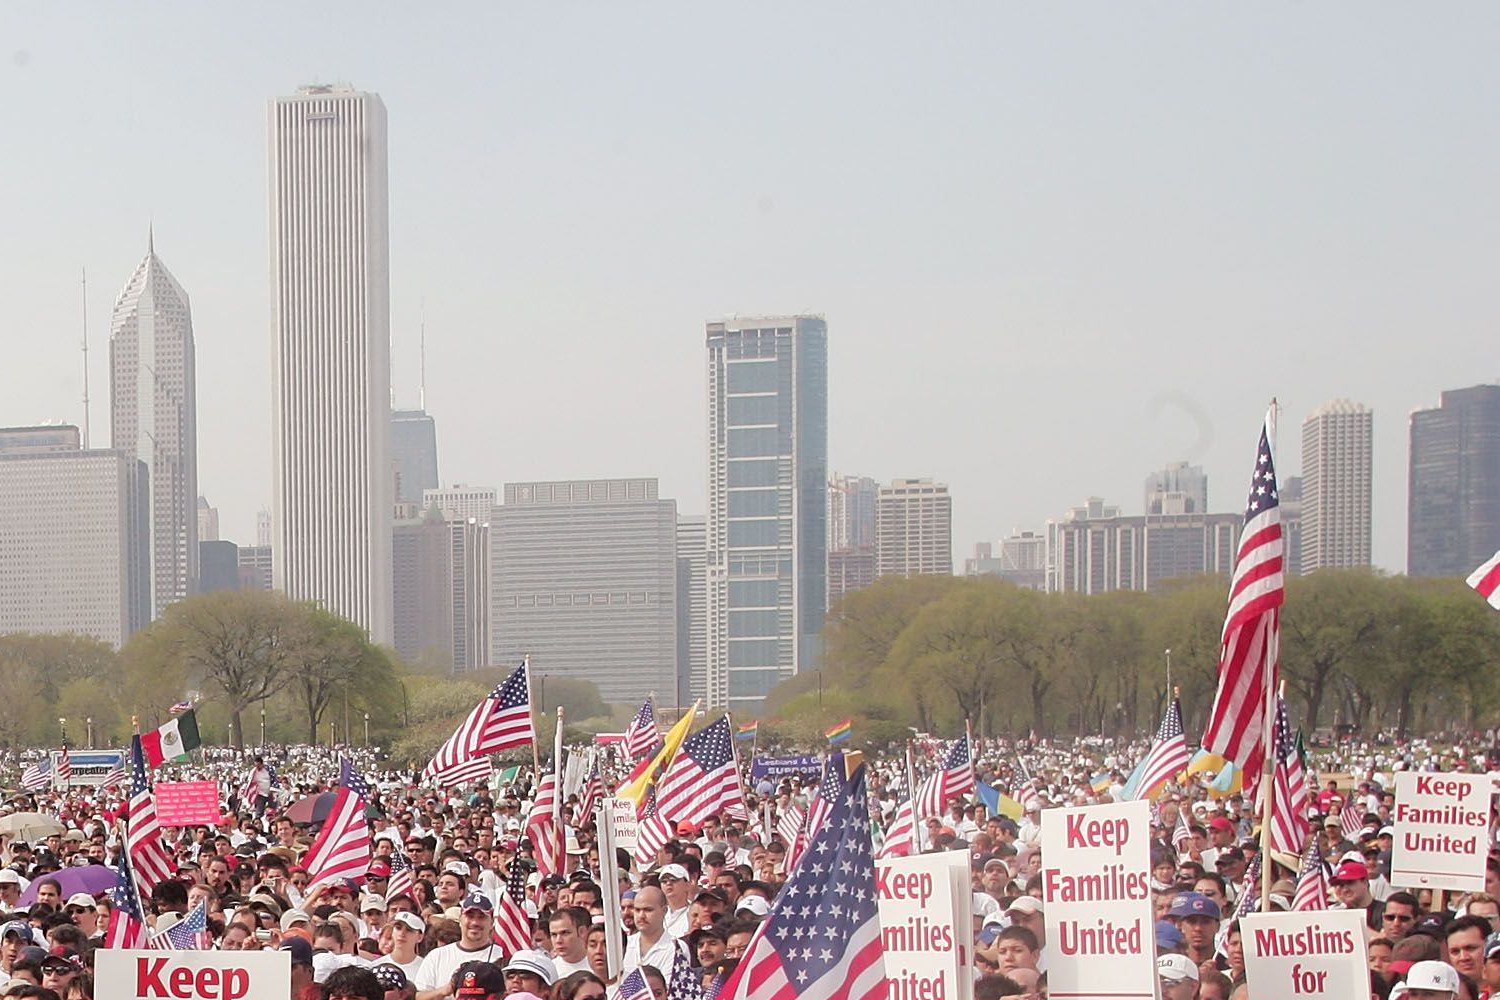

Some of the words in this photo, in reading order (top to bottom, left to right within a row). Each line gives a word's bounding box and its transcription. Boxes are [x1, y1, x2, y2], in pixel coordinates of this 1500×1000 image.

[70, 766, 113, 775] arpenter
[757, 758, 798, 766] Lesbians
[1416, 775, 1472, 802] Keep
[611, 799, 631, 811] Keep
[1397, 803, 1487, 827] Families
[1066, 813, 1130, 856] Keep
[1404, 832, 1477, 855] United
[874, 866, 933, 909] Keep
[1045, 864, 1149, 902] Families
[882, 916, 953, 952] milies
[1059, 917, 1142, 956] United
[1254, 924, 1355, 957] Muslims
[1292, 964, 1327, 994] for
